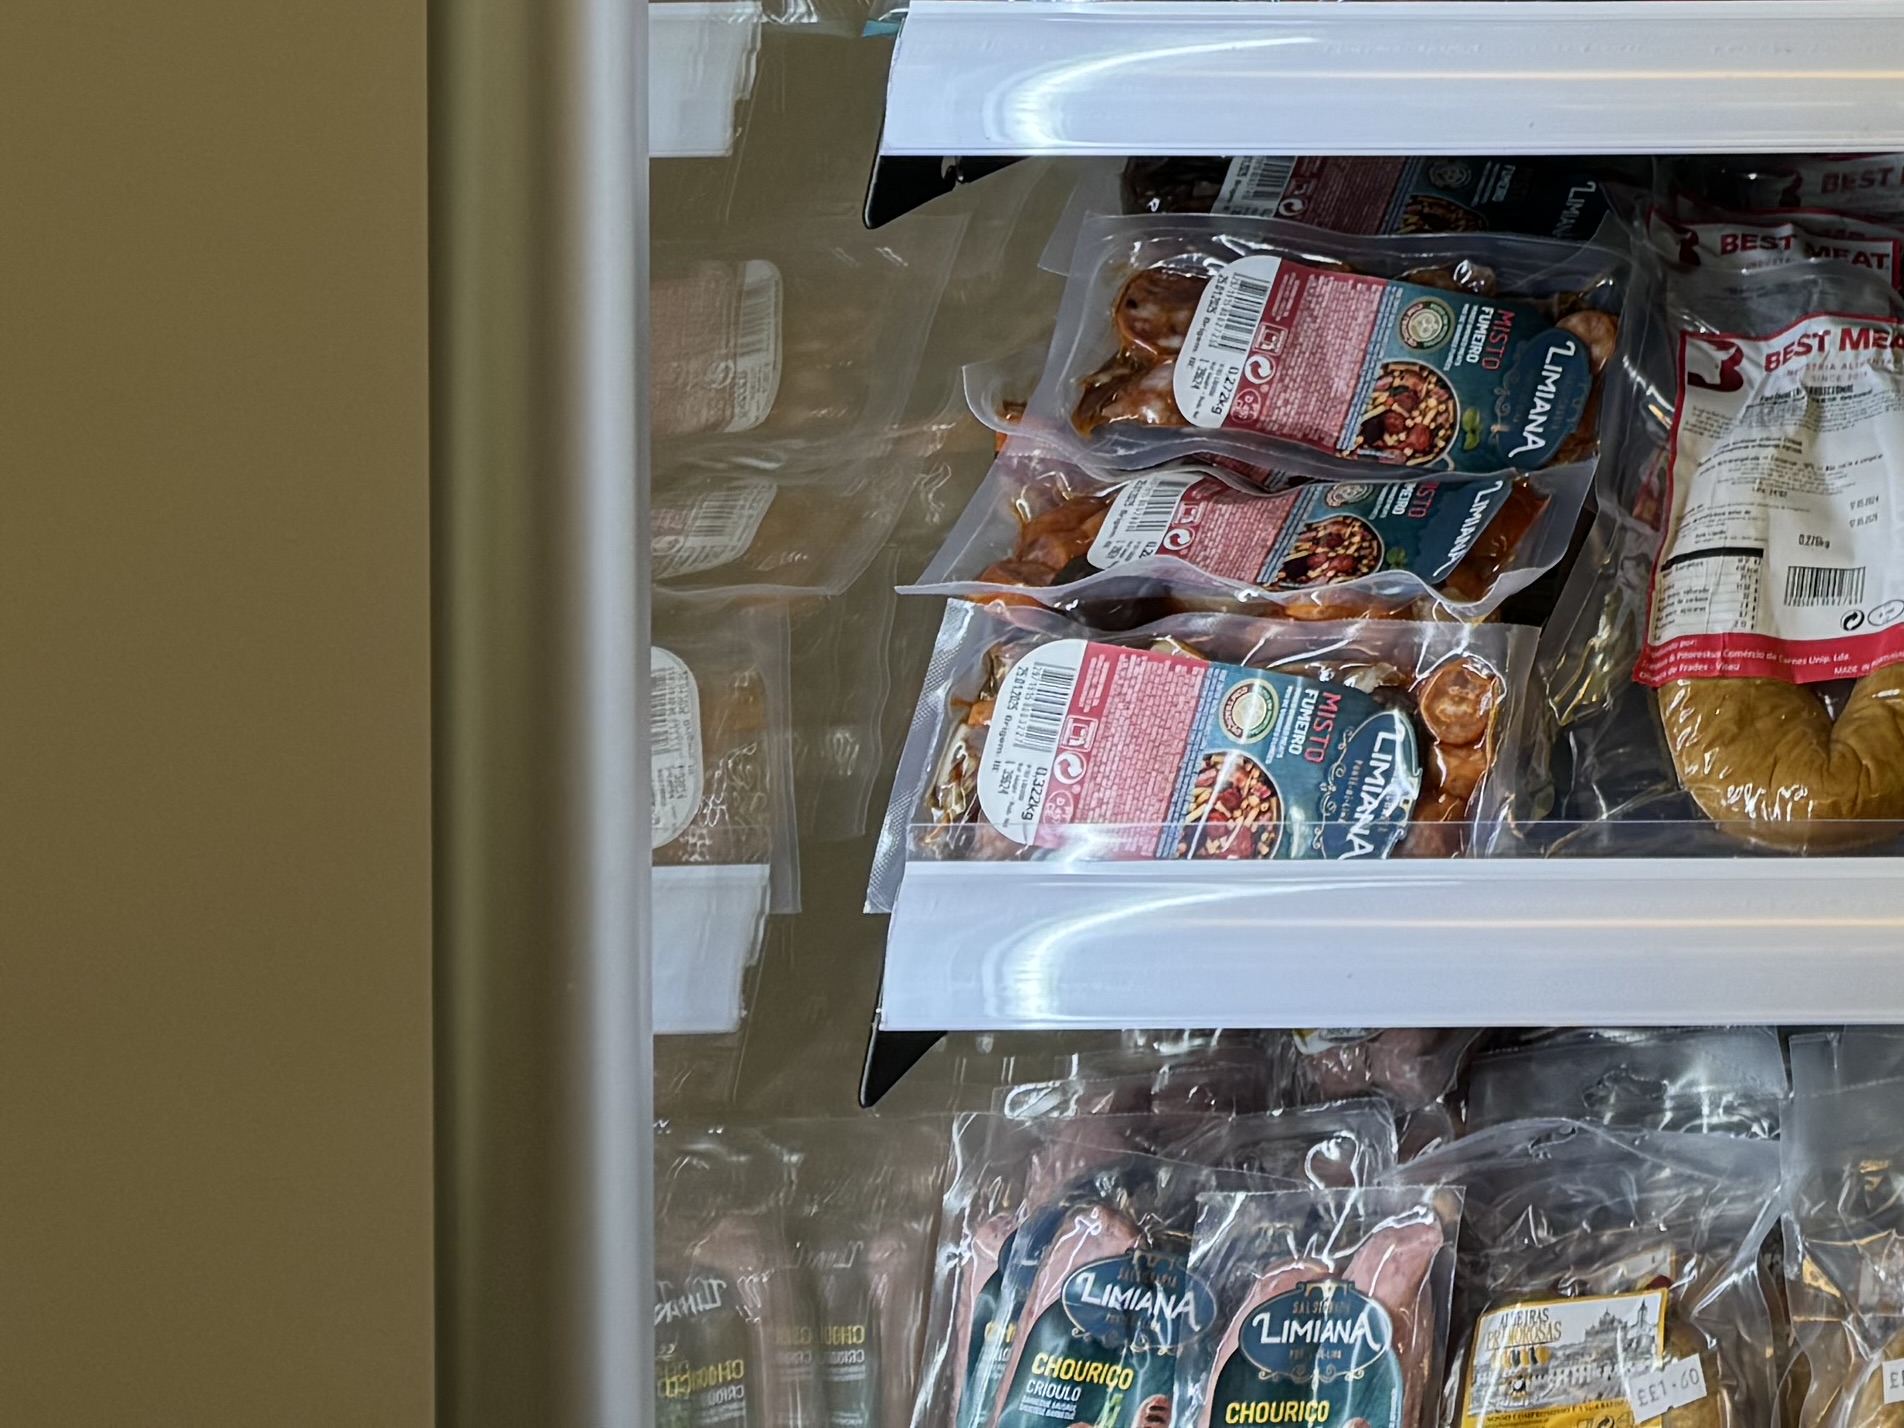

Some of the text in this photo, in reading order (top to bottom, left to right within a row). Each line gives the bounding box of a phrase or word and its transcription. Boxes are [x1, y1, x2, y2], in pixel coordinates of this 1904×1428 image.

[1820, 164, 1896, 195] BEST
[1720, 231, 1891, 270] BEST MEAT
[1465, 306, 1495, 364] FUMEIRO
[1480, 309, 1515, 372] MISTO
[1764, 329, 1832, 374] BEST
[1508, 341, 1576, 459] LIMIANA
[1433, 479, 1504, 578] LIMIANA
[1287, 686, 1319, 758] FUMEIRO
[1304, 690, 1343, 766] MISTO
[1338, 727, 1403, 861] LIMIANA
[1077, 1272, 1201, 1332] LIMIANA
[1252, 1311, 1384, 1353] LIMIANA
[1025, 1379, 1082, 1401] CRIOULO
[1030, 1351, 1135, 1391] CHOURIÇO
